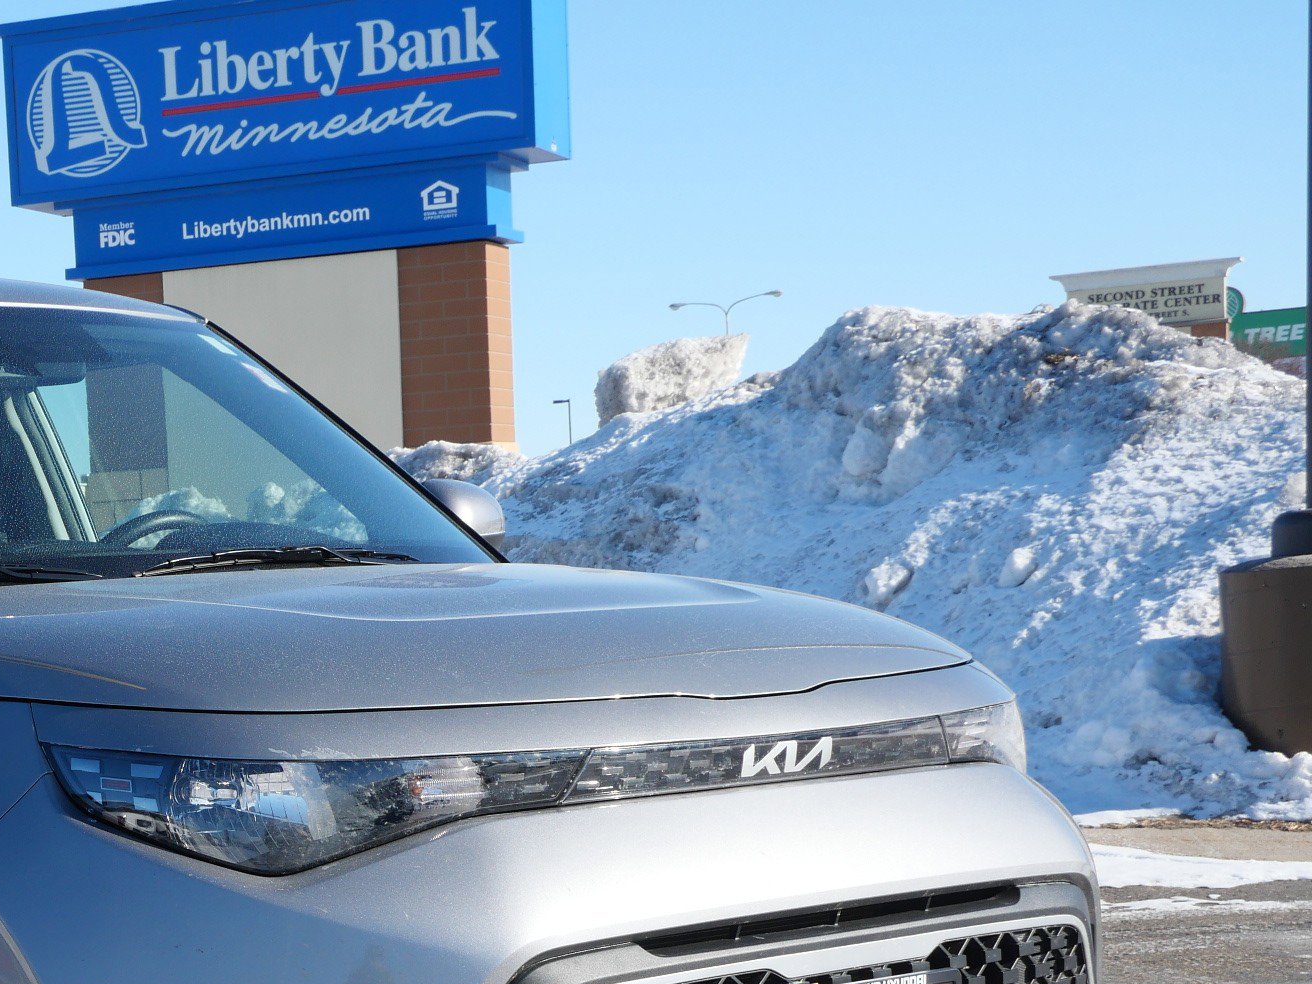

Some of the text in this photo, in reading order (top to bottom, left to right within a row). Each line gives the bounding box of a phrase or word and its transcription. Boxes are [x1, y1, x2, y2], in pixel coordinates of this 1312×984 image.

[159, 7, 500, 101] Liberty Bank
[99, 221, 135, 231] Member
[182, 207, 370, 239] Libertybankmn.com
[99, 229, 136, 248] FDIC
[1087, 283, 1205, 304] SECOND STREET
[1163, 293, 1222, 308] CENTER
[1244, 323, 1307, 345] TREE
[740, 736, 833, 778] KIA
